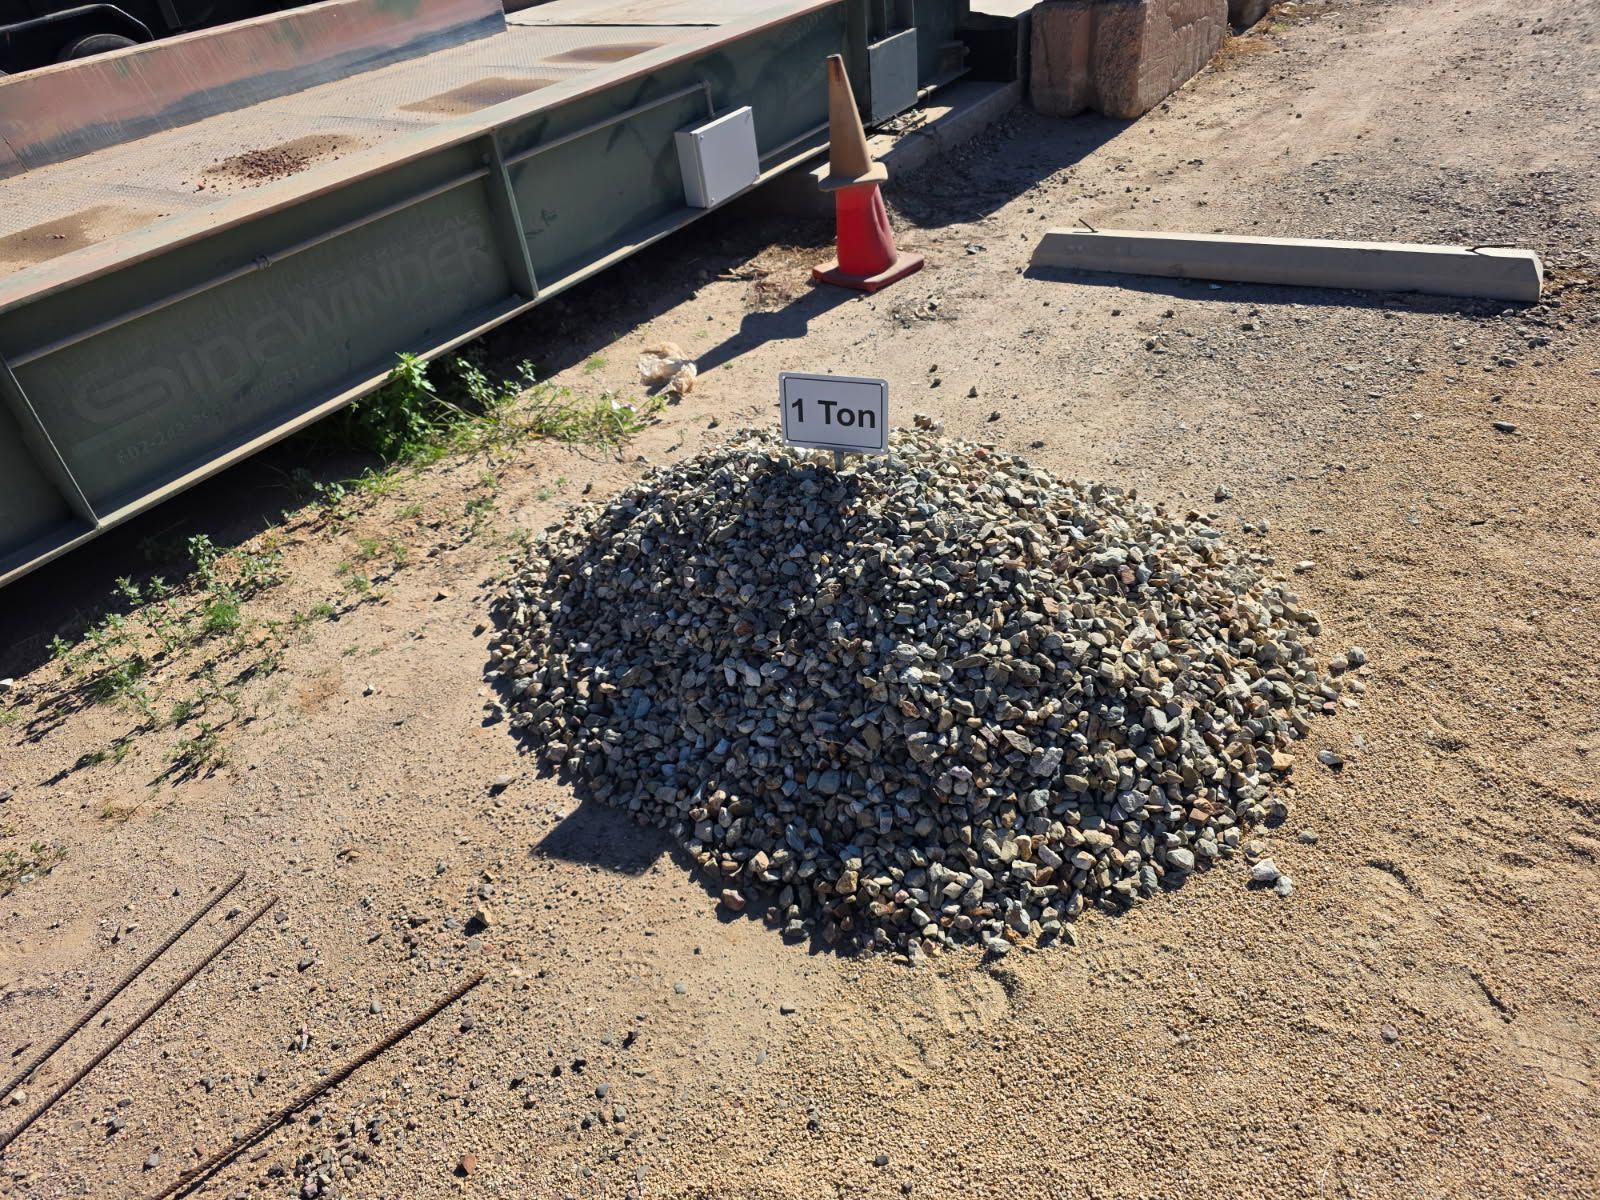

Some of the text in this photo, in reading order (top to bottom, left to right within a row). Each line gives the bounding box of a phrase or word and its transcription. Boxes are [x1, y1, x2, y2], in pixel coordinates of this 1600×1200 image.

[72, 222, 492, 425] SIDEWINDER
[791, 398, 876, 429] 1 Ton
